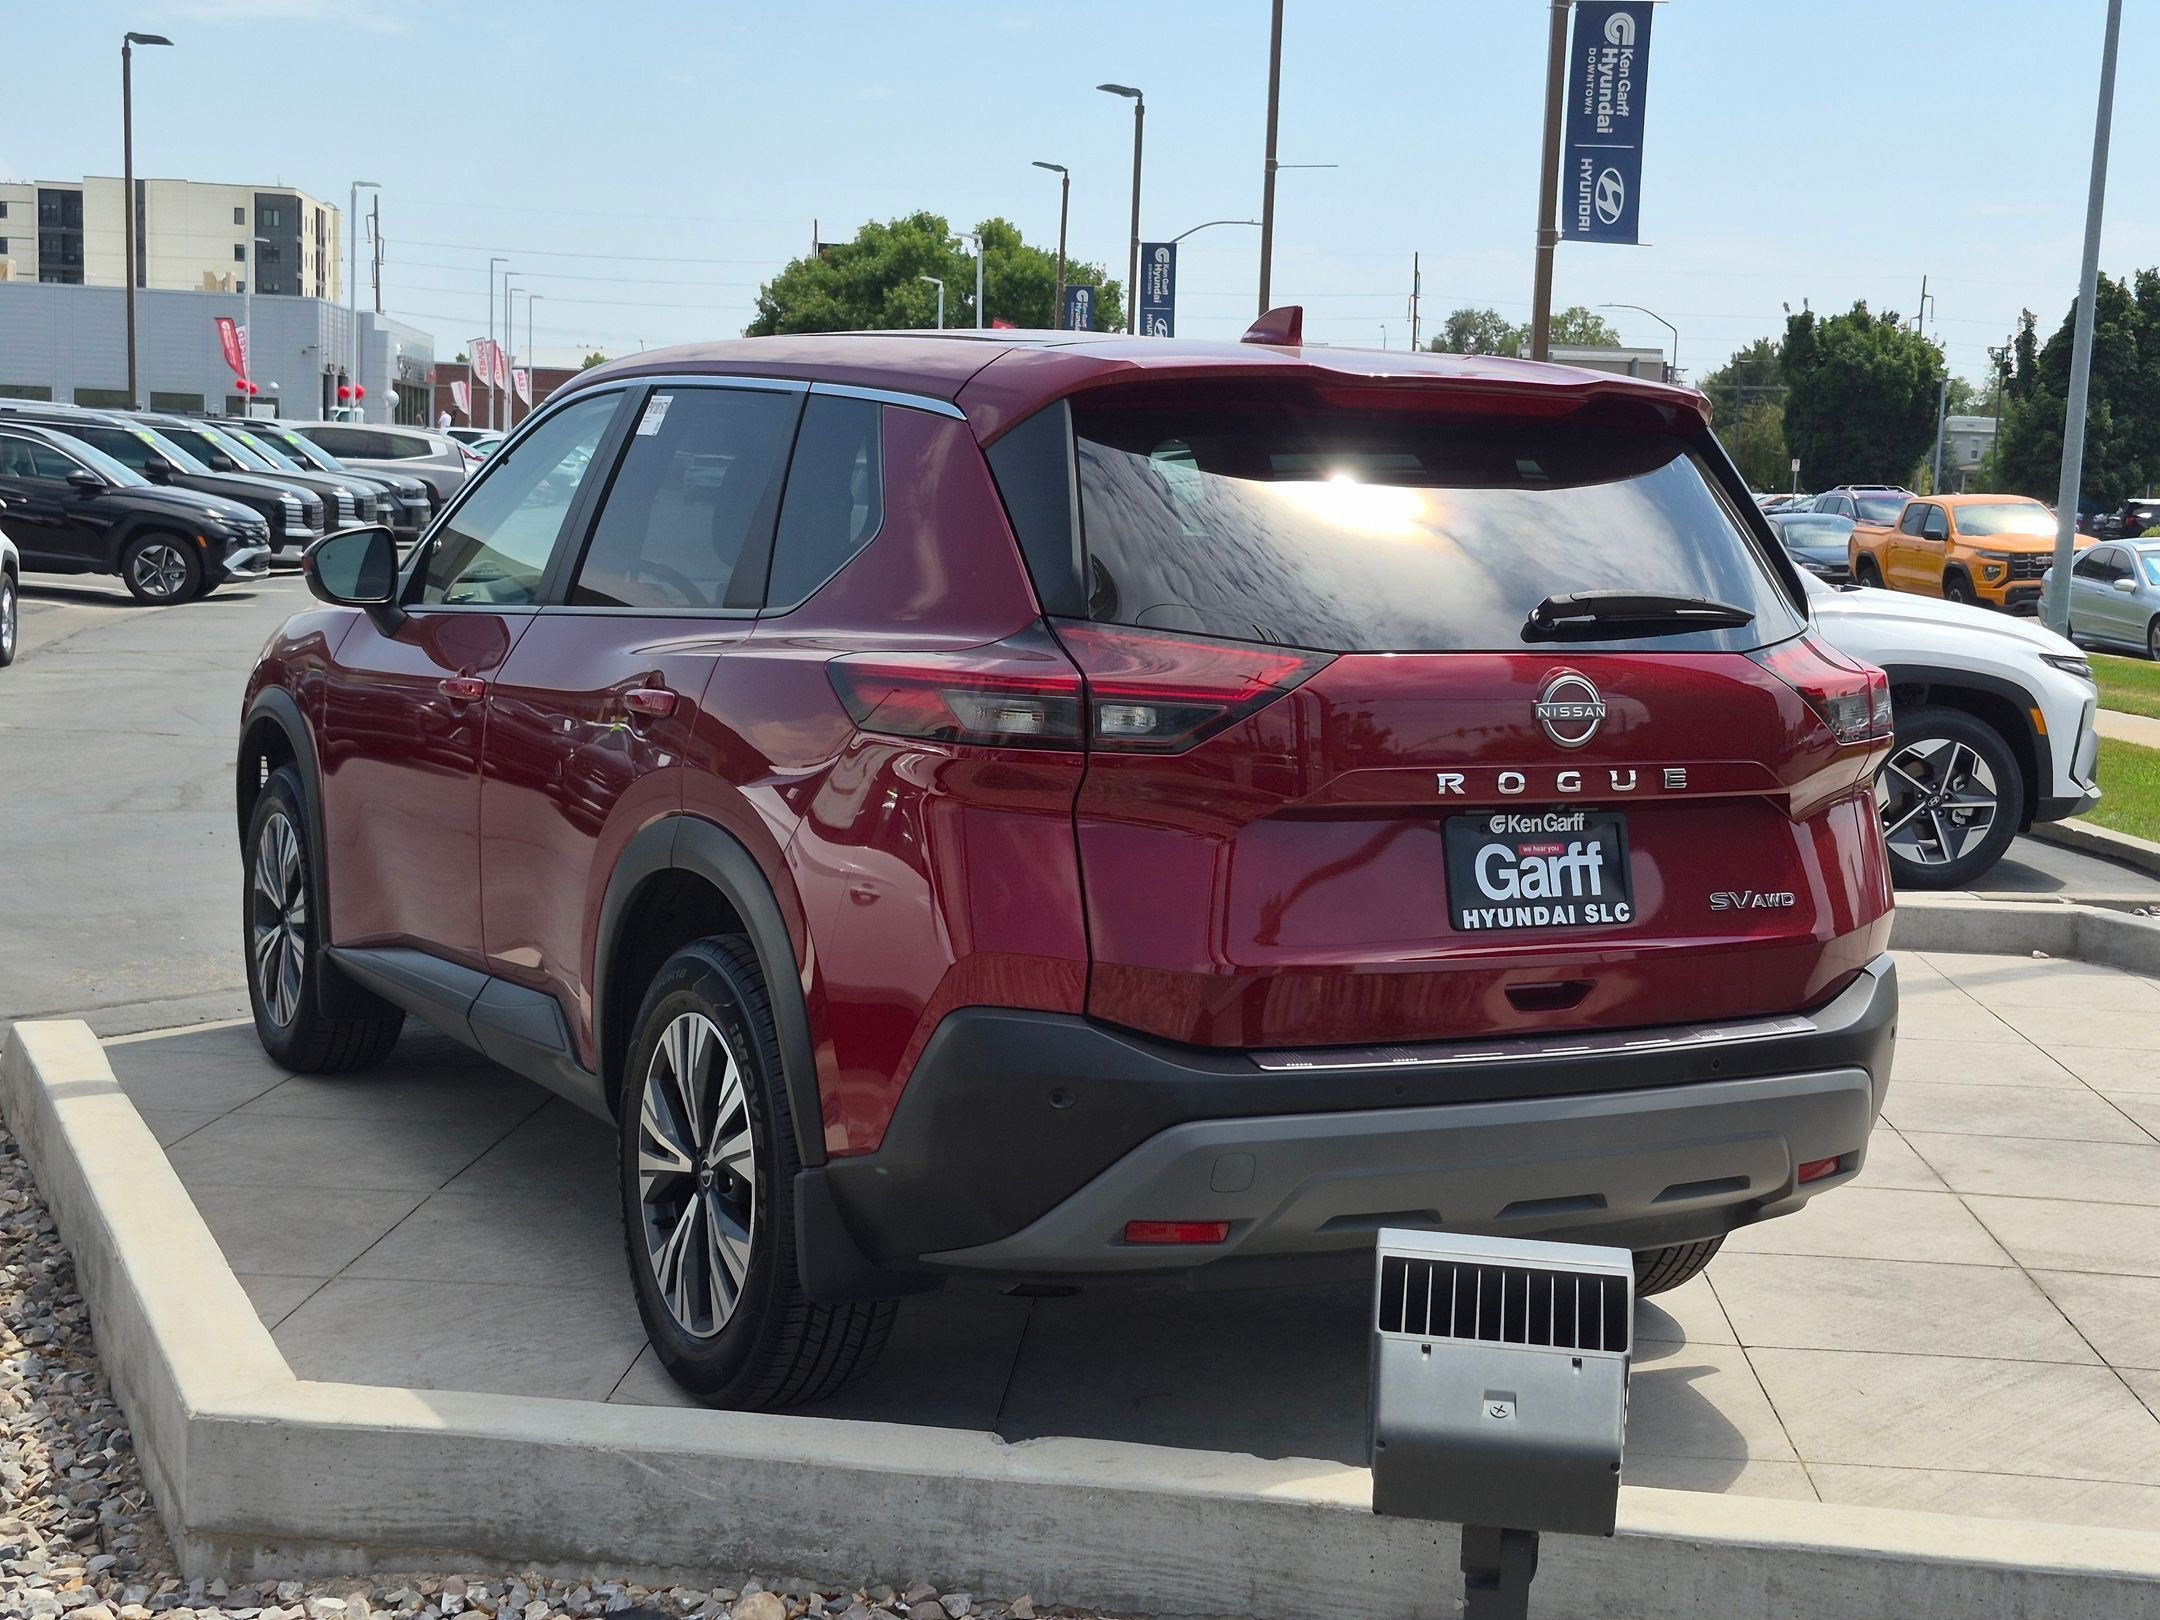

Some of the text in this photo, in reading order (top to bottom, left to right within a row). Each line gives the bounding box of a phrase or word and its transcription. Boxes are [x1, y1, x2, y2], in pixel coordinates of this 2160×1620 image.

[1584, 47, 1597, 115] DOWNTOWN
[1596, 48, 1619, 134] Hyundai
[1616, 48, 1634, 117] Ken Garff
[1578, 158, 1593, 232] HYUNDAI
[1153, 264, 1162, 303] Hyundai
[1538, 705, 1606, 718] NISSAN
[1437, 768, 1687, 795] ROGUE
[1475, 841, 1603, 900] Garff
[1547, 845, 1560, 853] you
[1463, 902, 1630, 929] HYUNDAI SLC
